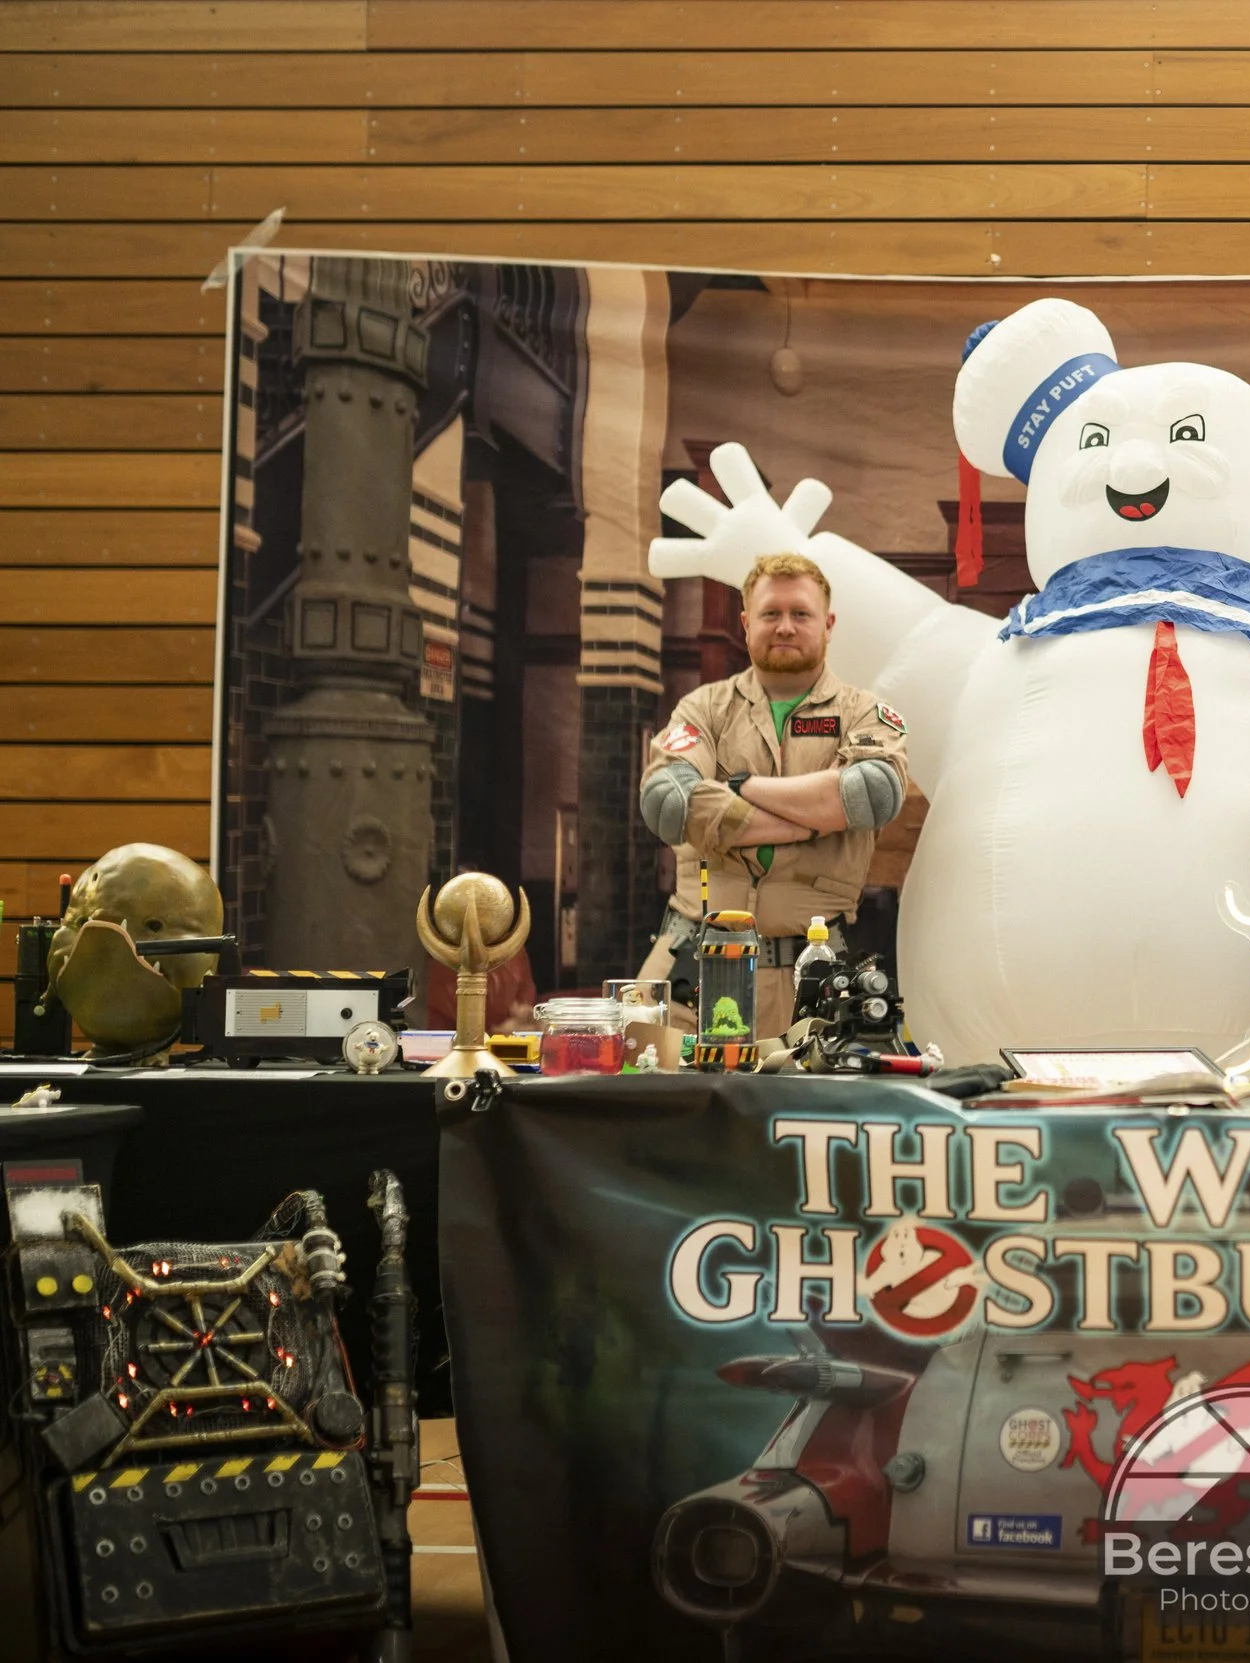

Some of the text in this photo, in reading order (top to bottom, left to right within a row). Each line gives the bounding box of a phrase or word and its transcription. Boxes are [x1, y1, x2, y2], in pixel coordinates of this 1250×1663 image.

[1017, 364, 1096, 449] STAY PUFT
[793, 718, 836, 734] GUMMER
[771, 1117, 1050, 1224] THE
[998, 1529, 1053, 1545] facebook
